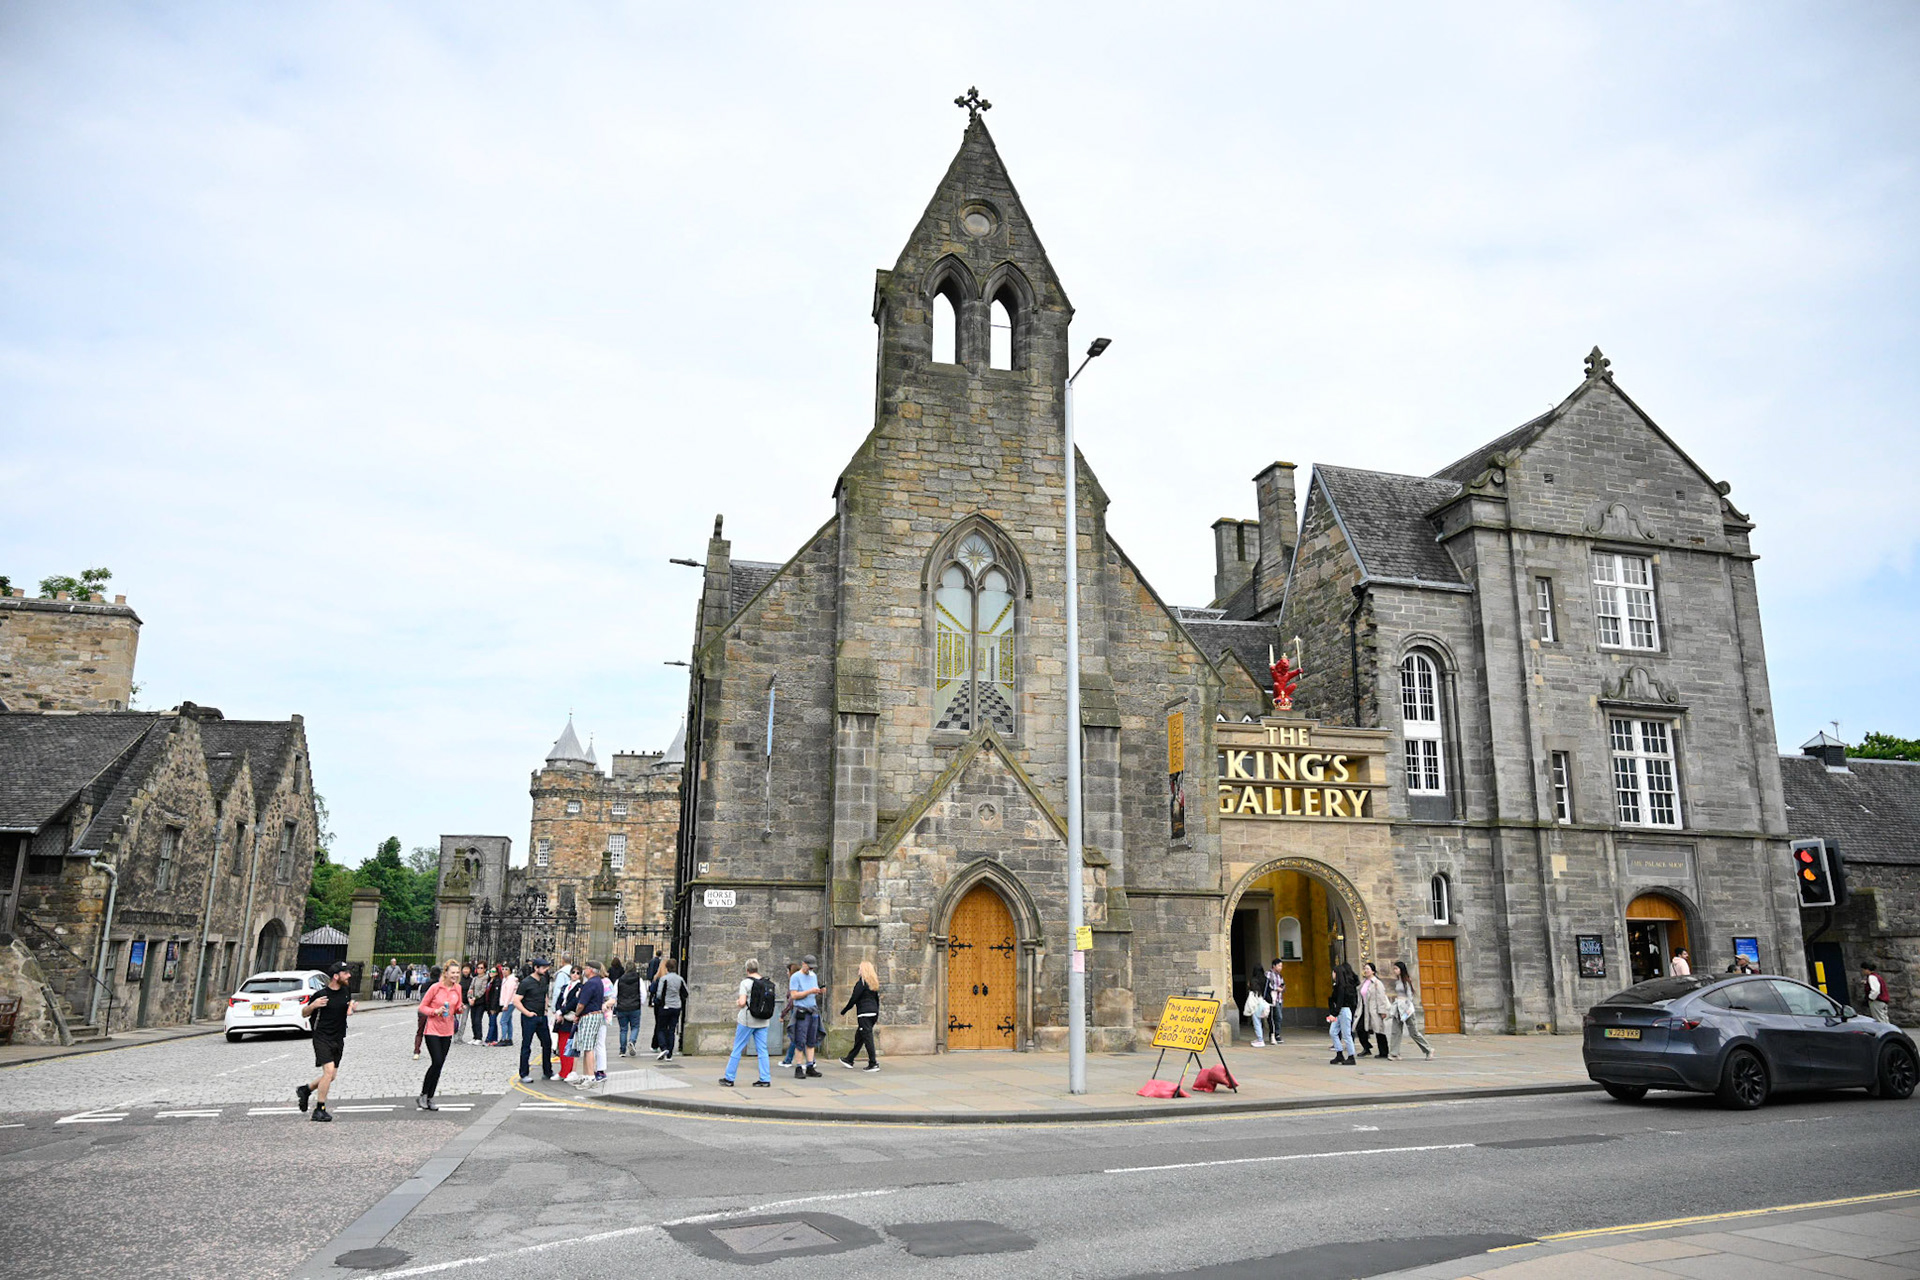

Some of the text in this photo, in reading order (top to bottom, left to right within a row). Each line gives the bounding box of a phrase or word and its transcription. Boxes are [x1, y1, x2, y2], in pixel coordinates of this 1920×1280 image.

[1265, 726, 1311, 746] THE
[1226, 750, 1350, 783] KING'S
[1218, 784, 1370, 818] GALLERY
[1168, 1002, 1215, 1014] This road will
[1180, 1014, 1206, 1024] closed
[1159, 1023, 1208, 1036] Sun 2 June 24
[1157, 1032, 1178, 1041] 0600
[1184, 1035, 1204, 1045] 1300
